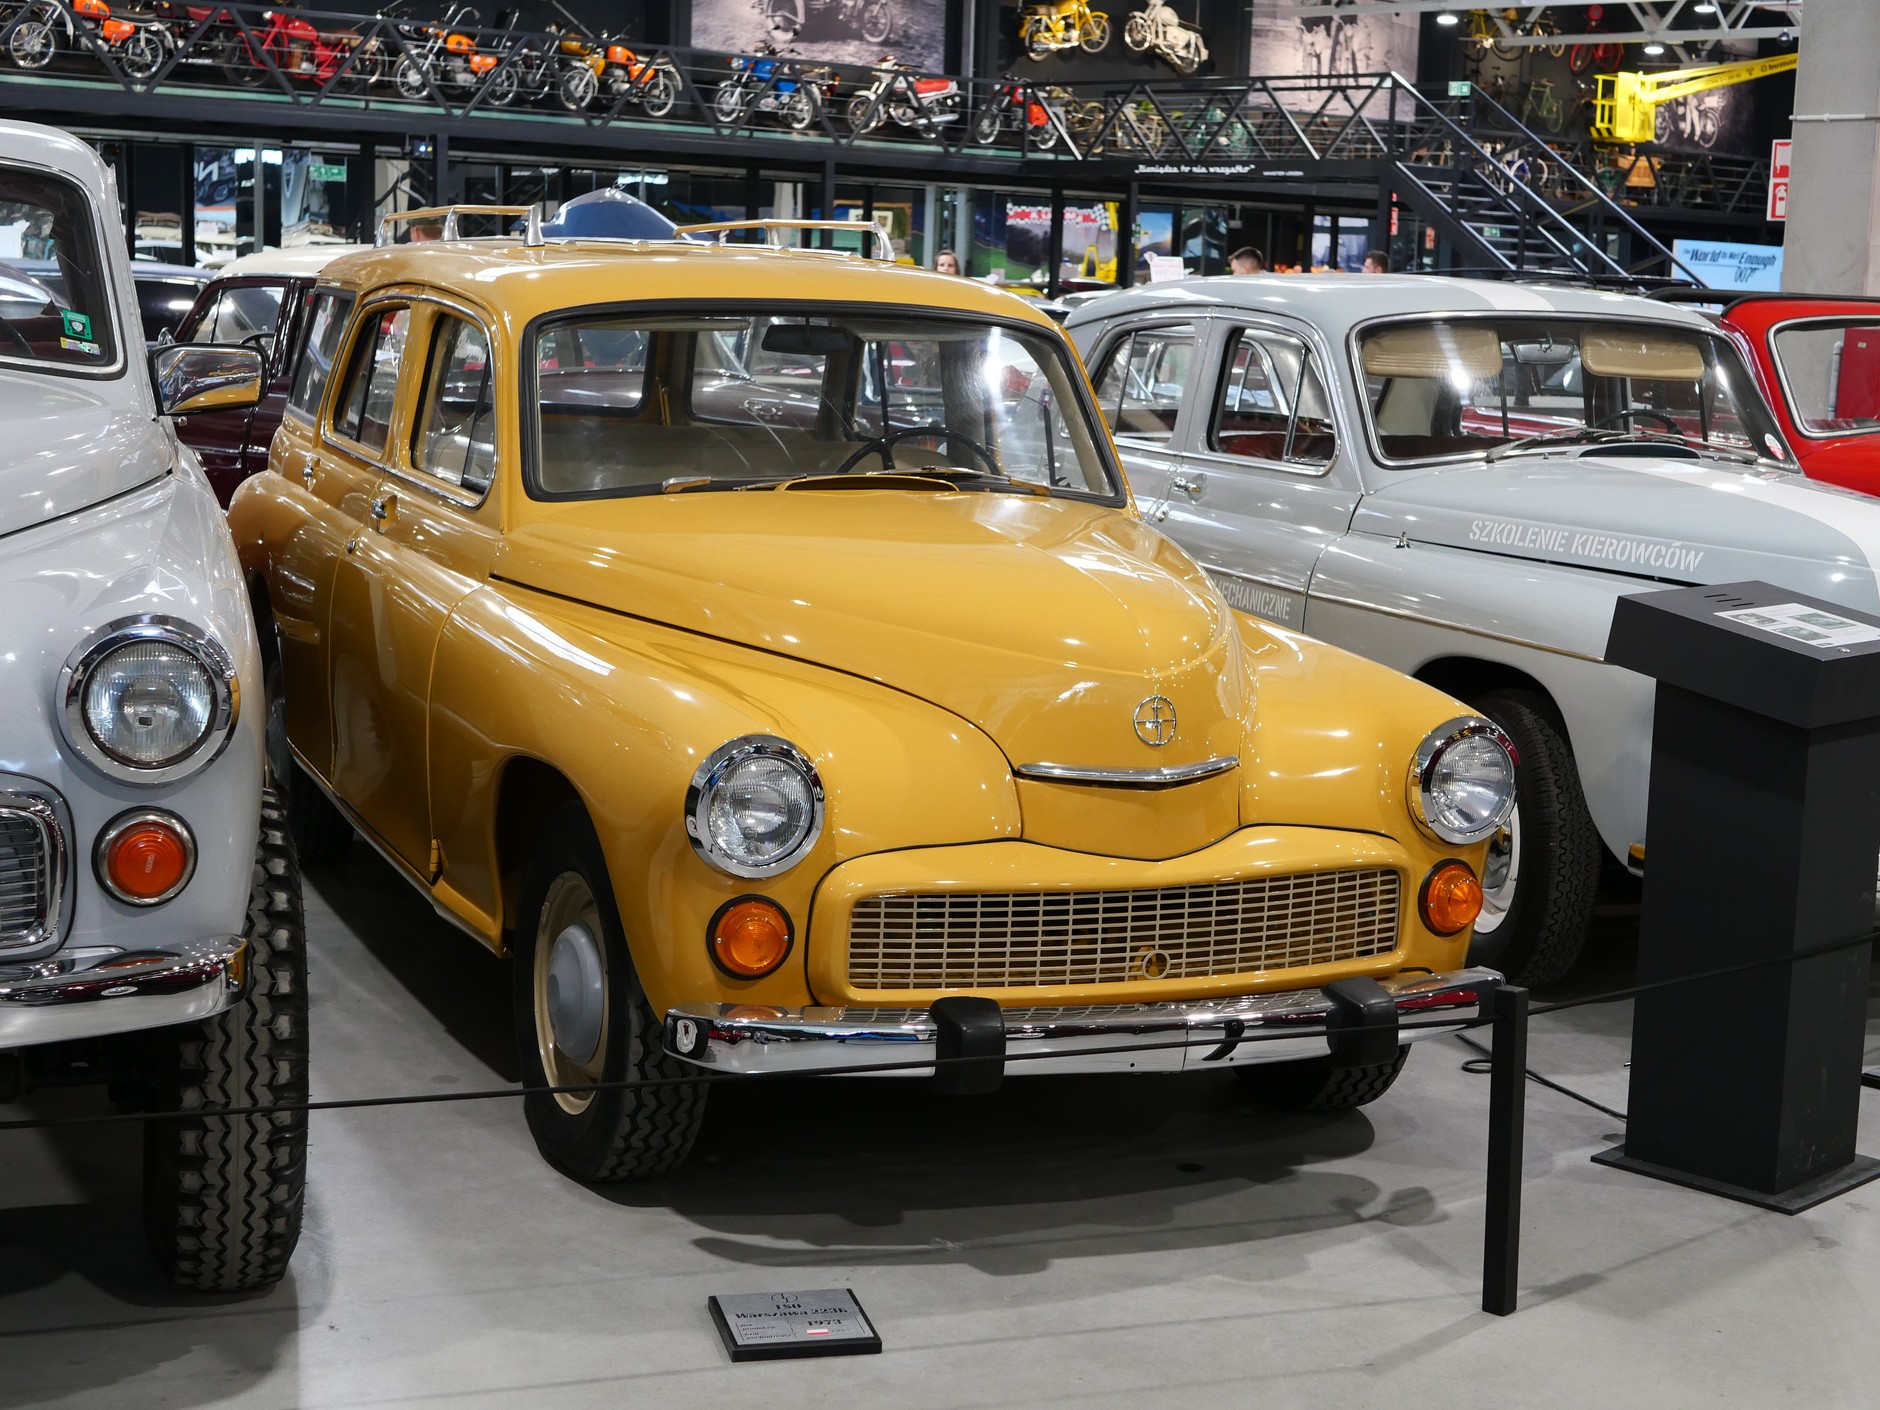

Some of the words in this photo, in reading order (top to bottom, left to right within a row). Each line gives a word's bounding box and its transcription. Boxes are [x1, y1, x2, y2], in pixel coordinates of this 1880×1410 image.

[1690, 247, 1722, 263] World
[1739, 251, 1777, 270] Enough
[1734, 266, 1758, 283] 007
[1469, 519, 1569, 553] SZKOLENIE
[1570, 533, 1705, 572] KIEROWCÓW
[735, 1310, 808, 1319] Warszawa
